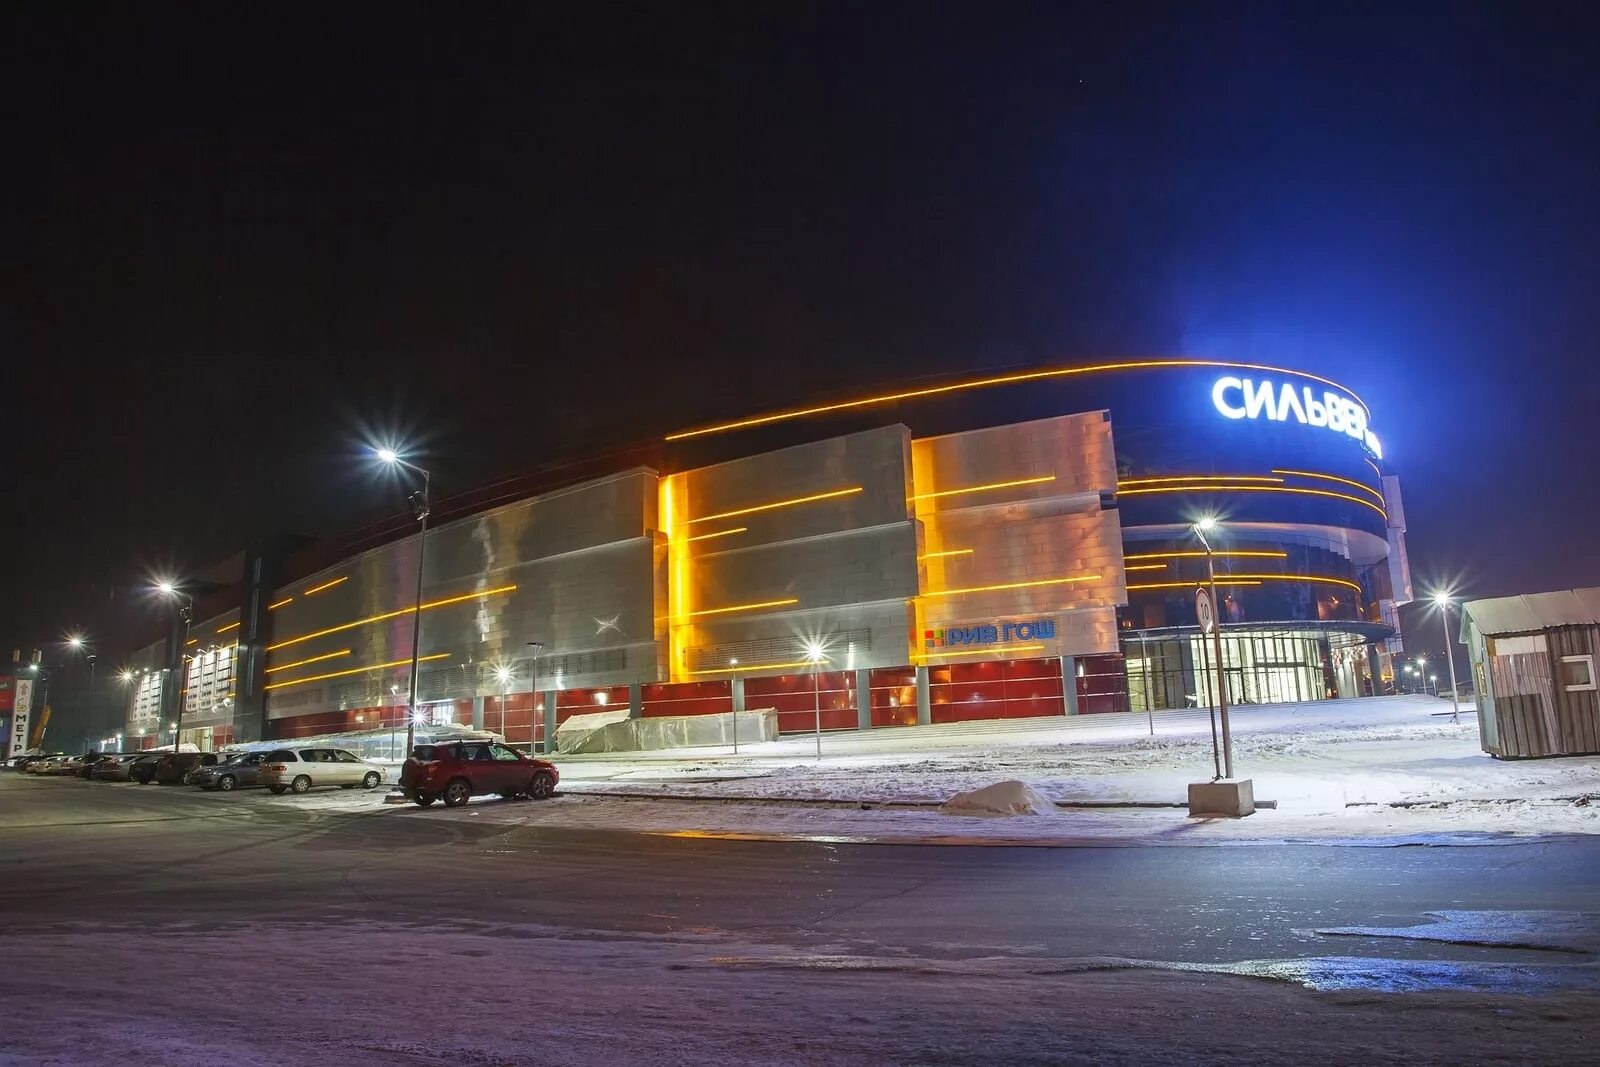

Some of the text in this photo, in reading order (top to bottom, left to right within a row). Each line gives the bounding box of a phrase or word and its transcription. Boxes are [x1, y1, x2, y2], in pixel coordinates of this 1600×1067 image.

[1200, 603, 1210, 620] 10
[947, 619, 1056, 646] РИВ ГОШ
[13, 714, 27, 752] МЕТР
